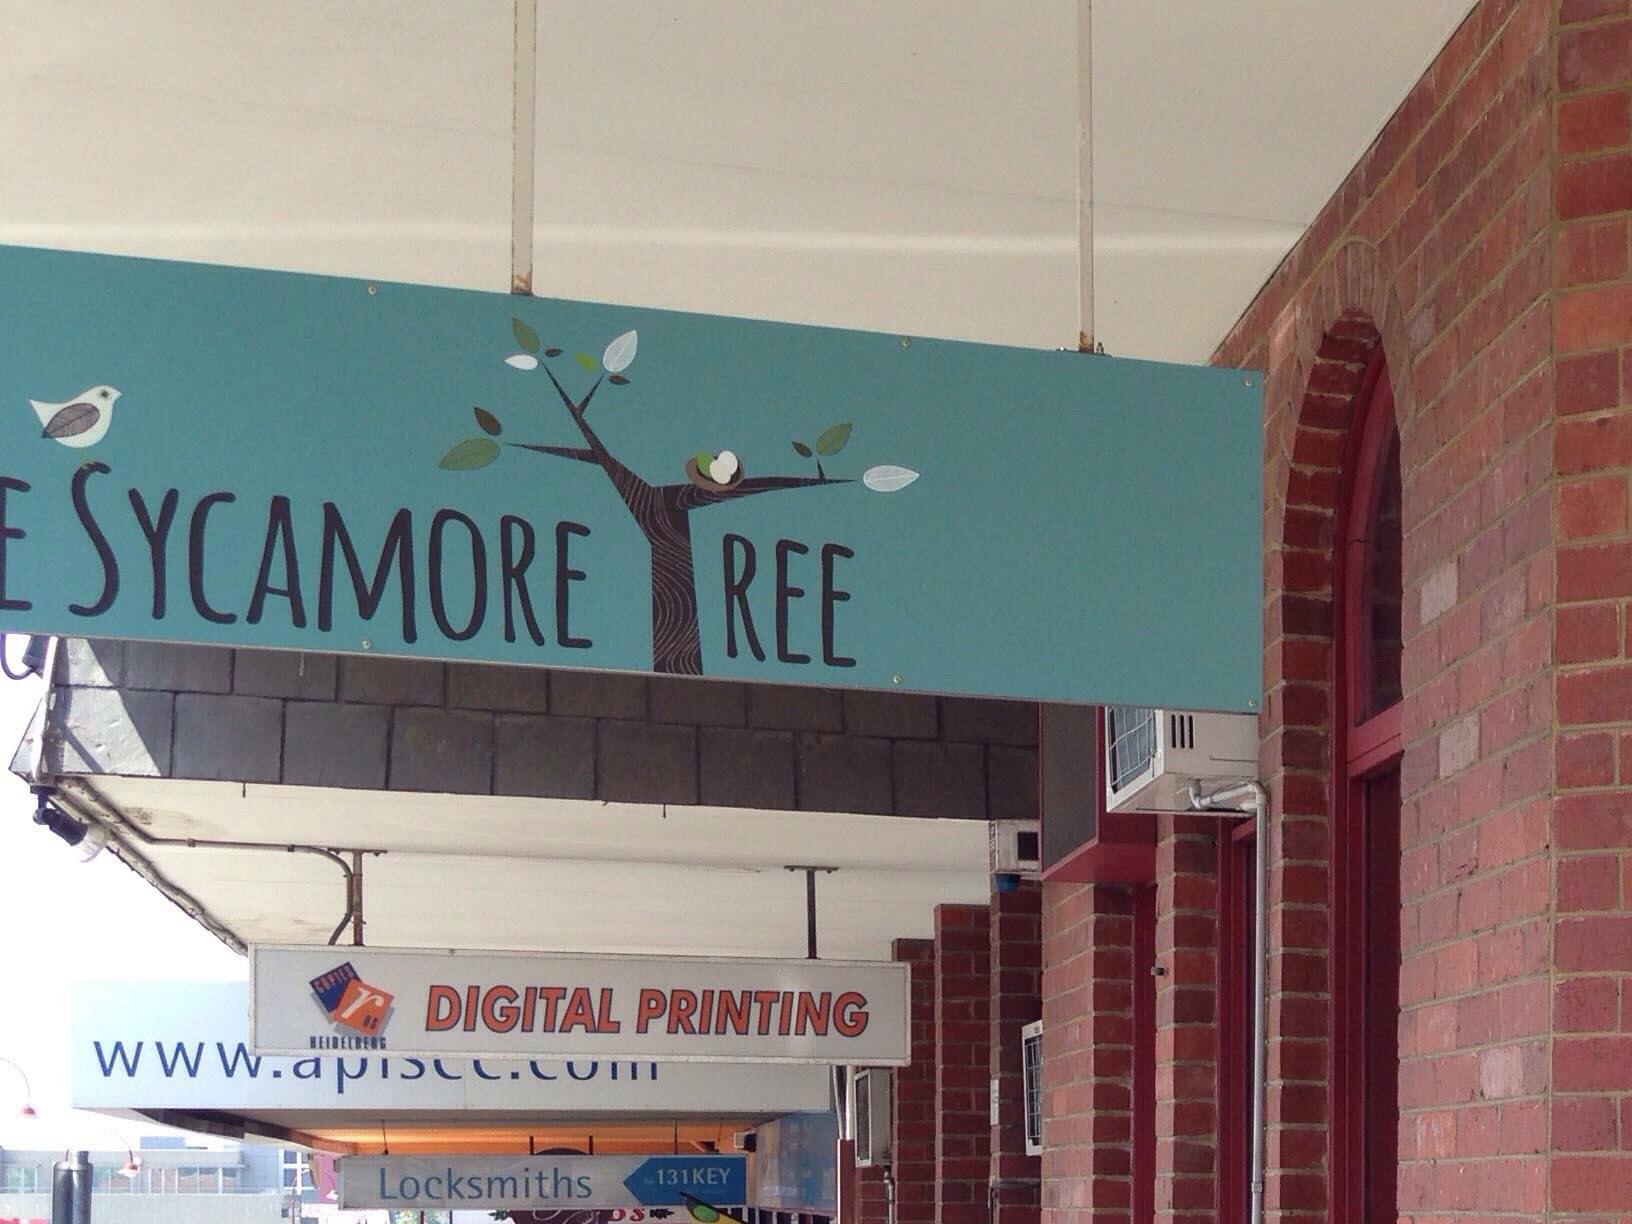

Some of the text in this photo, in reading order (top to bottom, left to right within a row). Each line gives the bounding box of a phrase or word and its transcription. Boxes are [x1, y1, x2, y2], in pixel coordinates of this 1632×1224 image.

[69, 461, 593, 649] SYCAMORE
[425, 984, 869, 1038] DIGITAL PRINTING
[310, 1035, 386, 1050] HEIDELBERG
[379, 1166, 731, 1200] Locksmiths 131KEY
